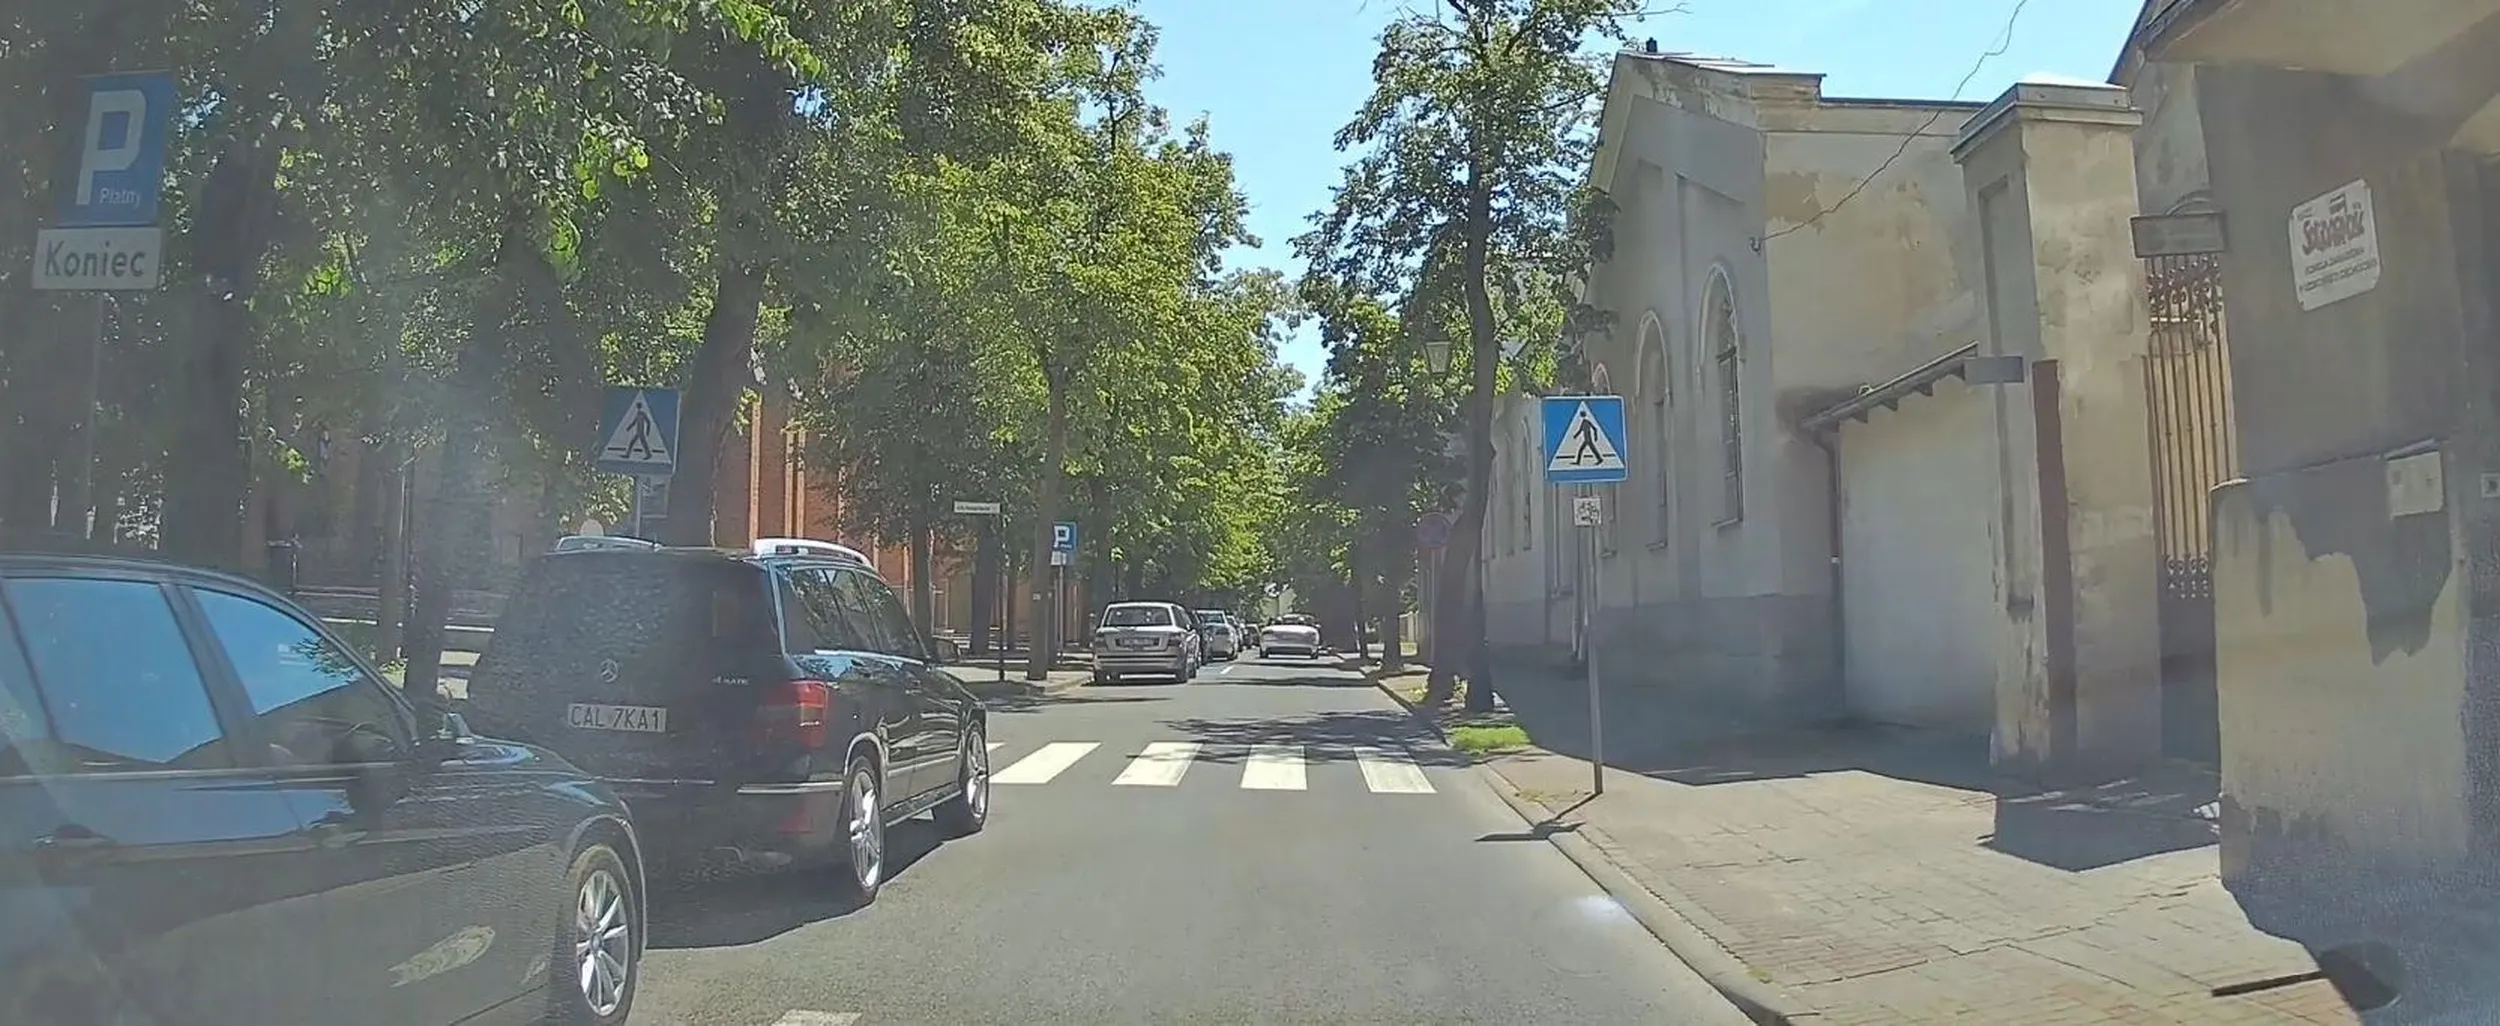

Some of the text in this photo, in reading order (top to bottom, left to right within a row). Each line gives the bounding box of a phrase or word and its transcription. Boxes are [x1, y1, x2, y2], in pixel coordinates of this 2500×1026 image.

[77, 89, 147, 205] P
[44, 241, 146, 277] Koniec
[1053, 525, 1070, 548] P
[570, 707, 659, 731] CAL 7KA1
